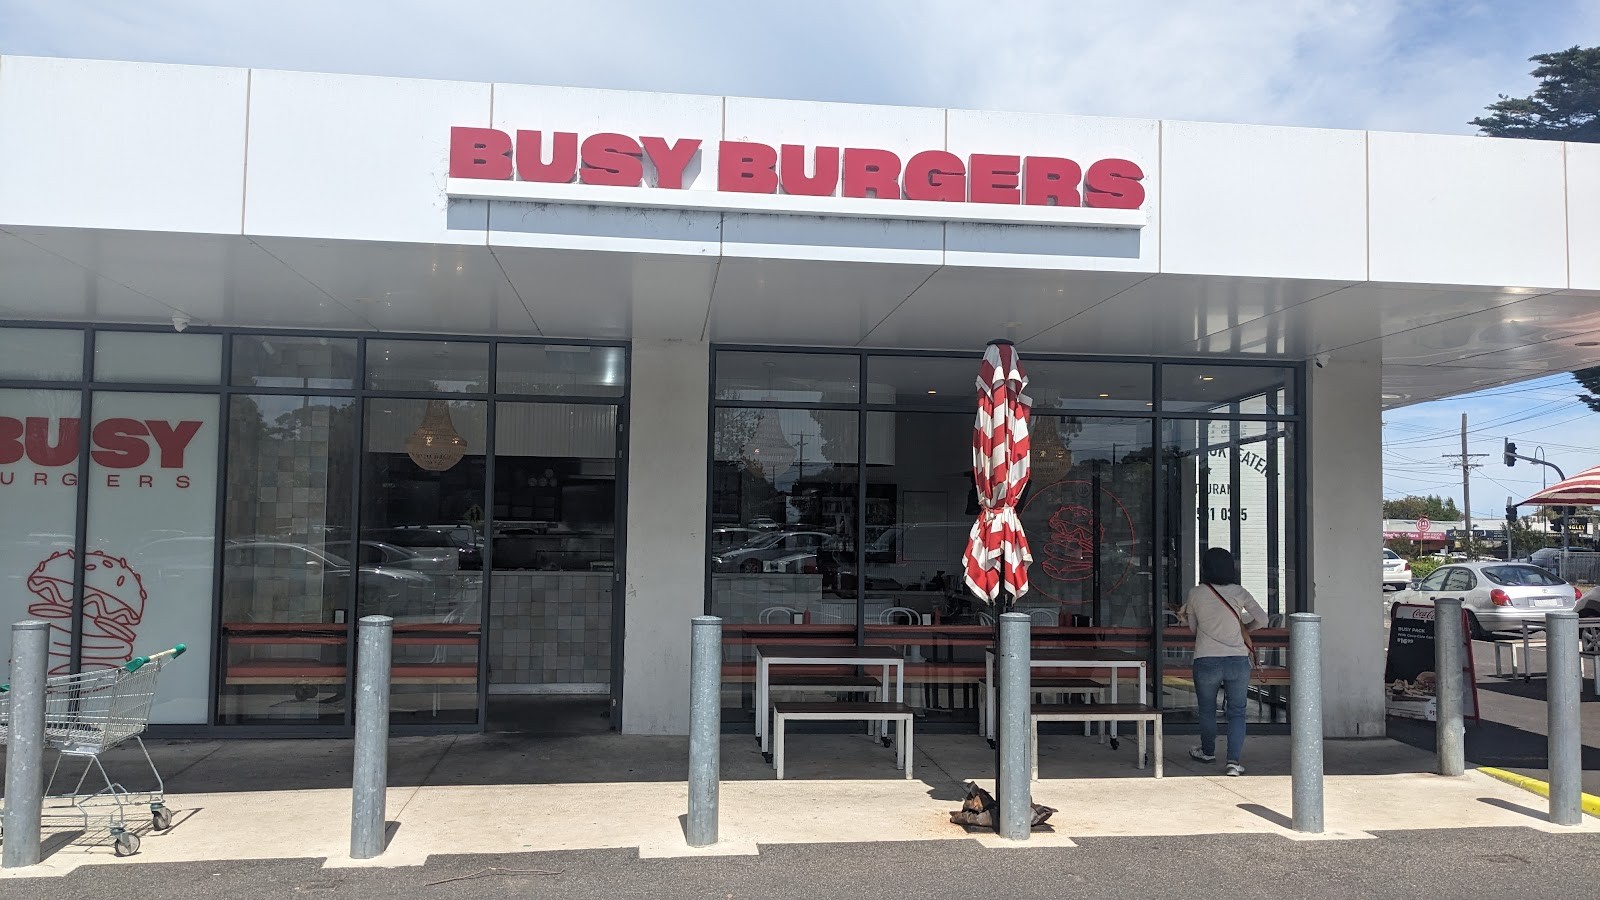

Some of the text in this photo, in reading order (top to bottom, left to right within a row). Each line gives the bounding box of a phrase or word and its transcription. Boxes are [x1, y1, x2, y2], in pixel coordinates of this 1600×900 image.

[450, 126, 1146, 209] BUSY BURGERS
[0, 472, 192, 489] URGERS
